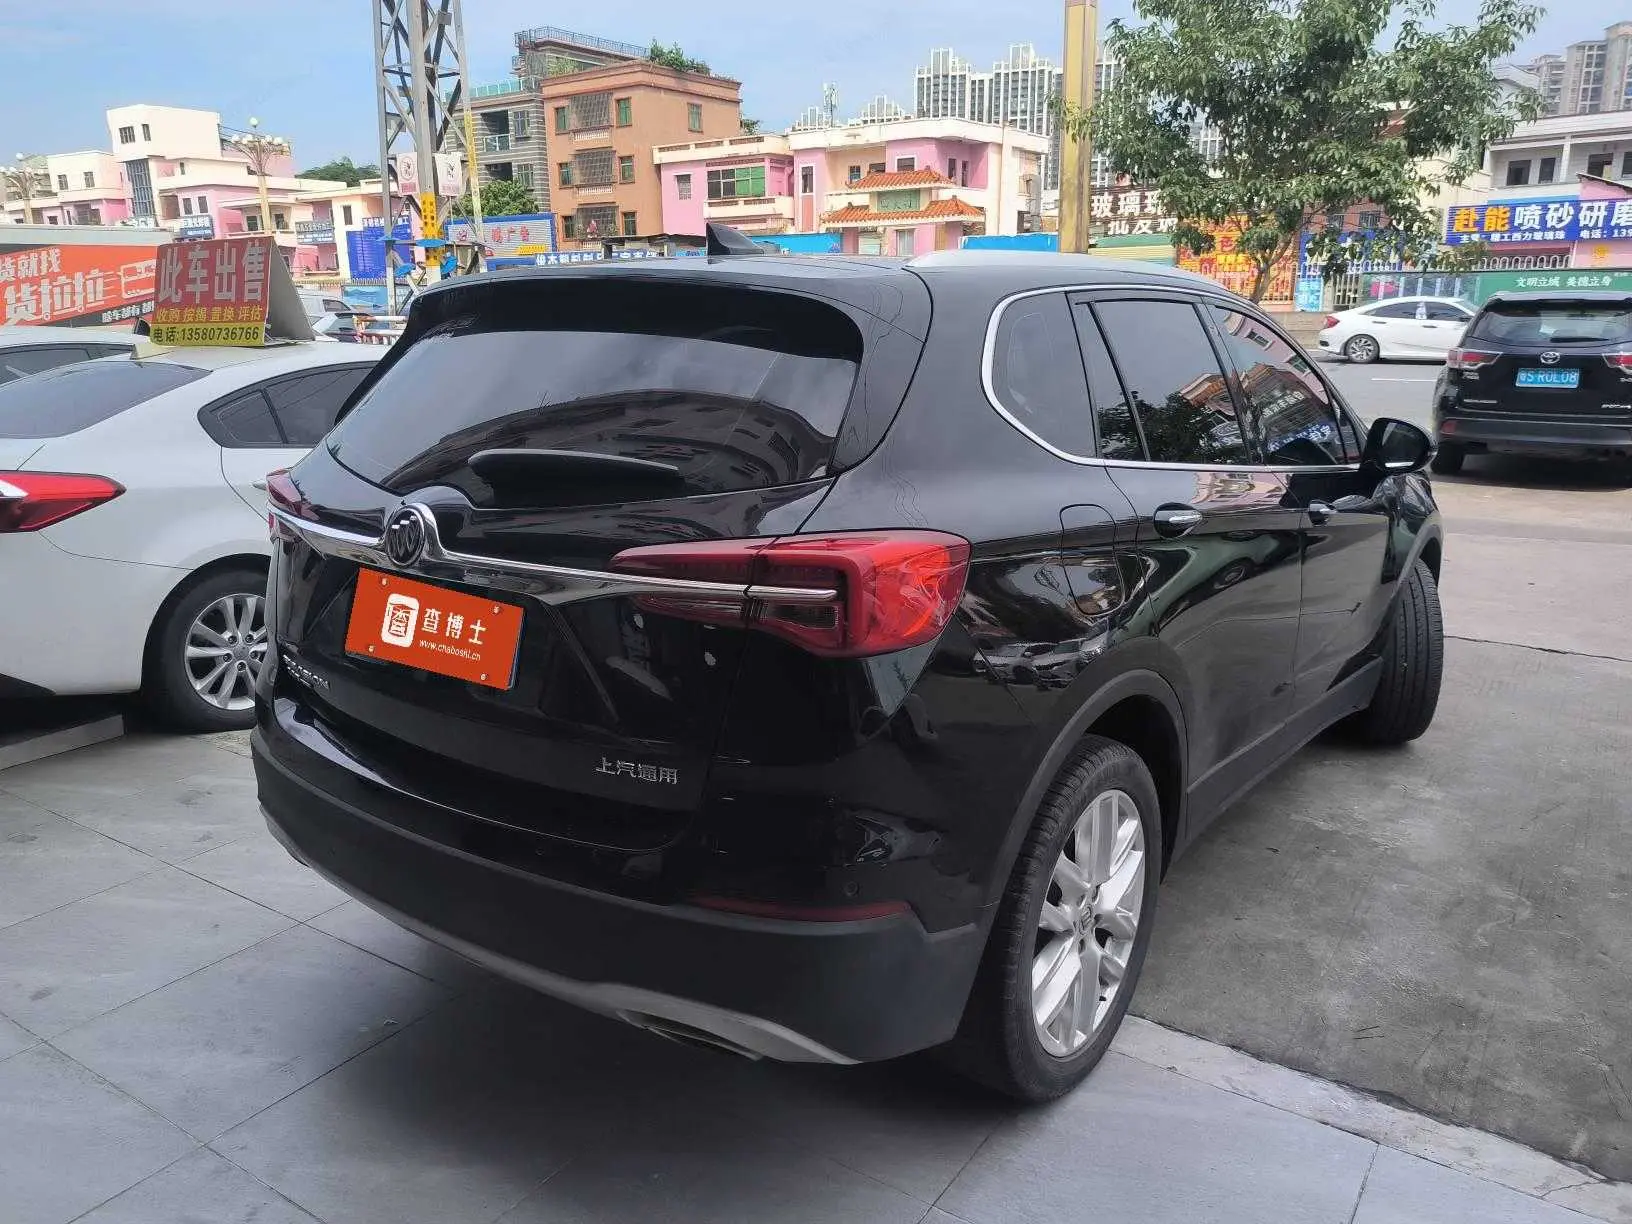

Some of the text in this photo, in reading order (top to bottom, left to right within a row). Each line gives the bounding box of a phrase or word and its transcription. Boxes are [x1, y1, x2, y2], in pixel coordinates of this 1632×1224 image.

[159, 239, 265, 304] 此车出售
[240, 304, 263, 320] 评估
[595, 756, 677, 785] 上汽通用
